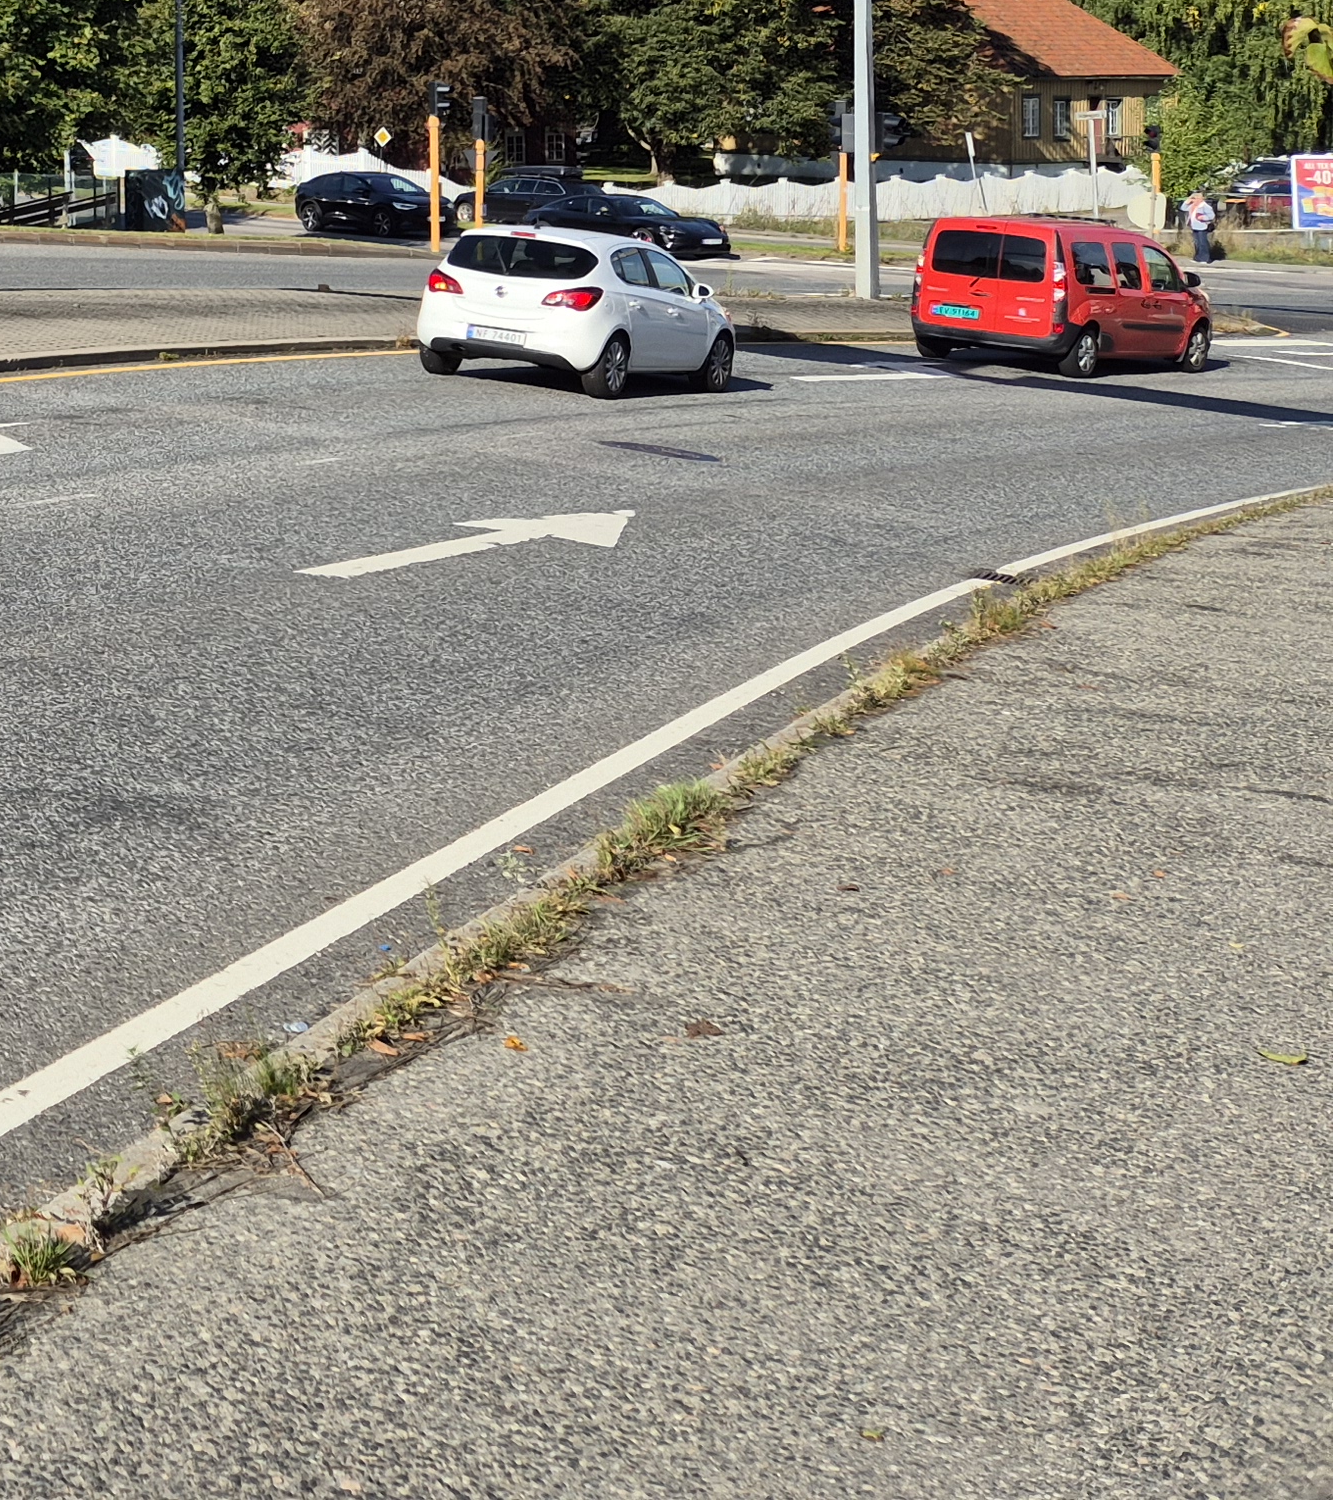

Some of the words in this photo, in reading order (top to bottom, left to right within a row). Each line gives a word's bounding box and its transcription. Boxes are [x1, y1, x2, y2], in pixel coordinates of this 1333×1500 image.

[1305, 170, 1333, 184] -40
[475, 328, 488, 338] NF
[492, 331, 522, 343] 74401
